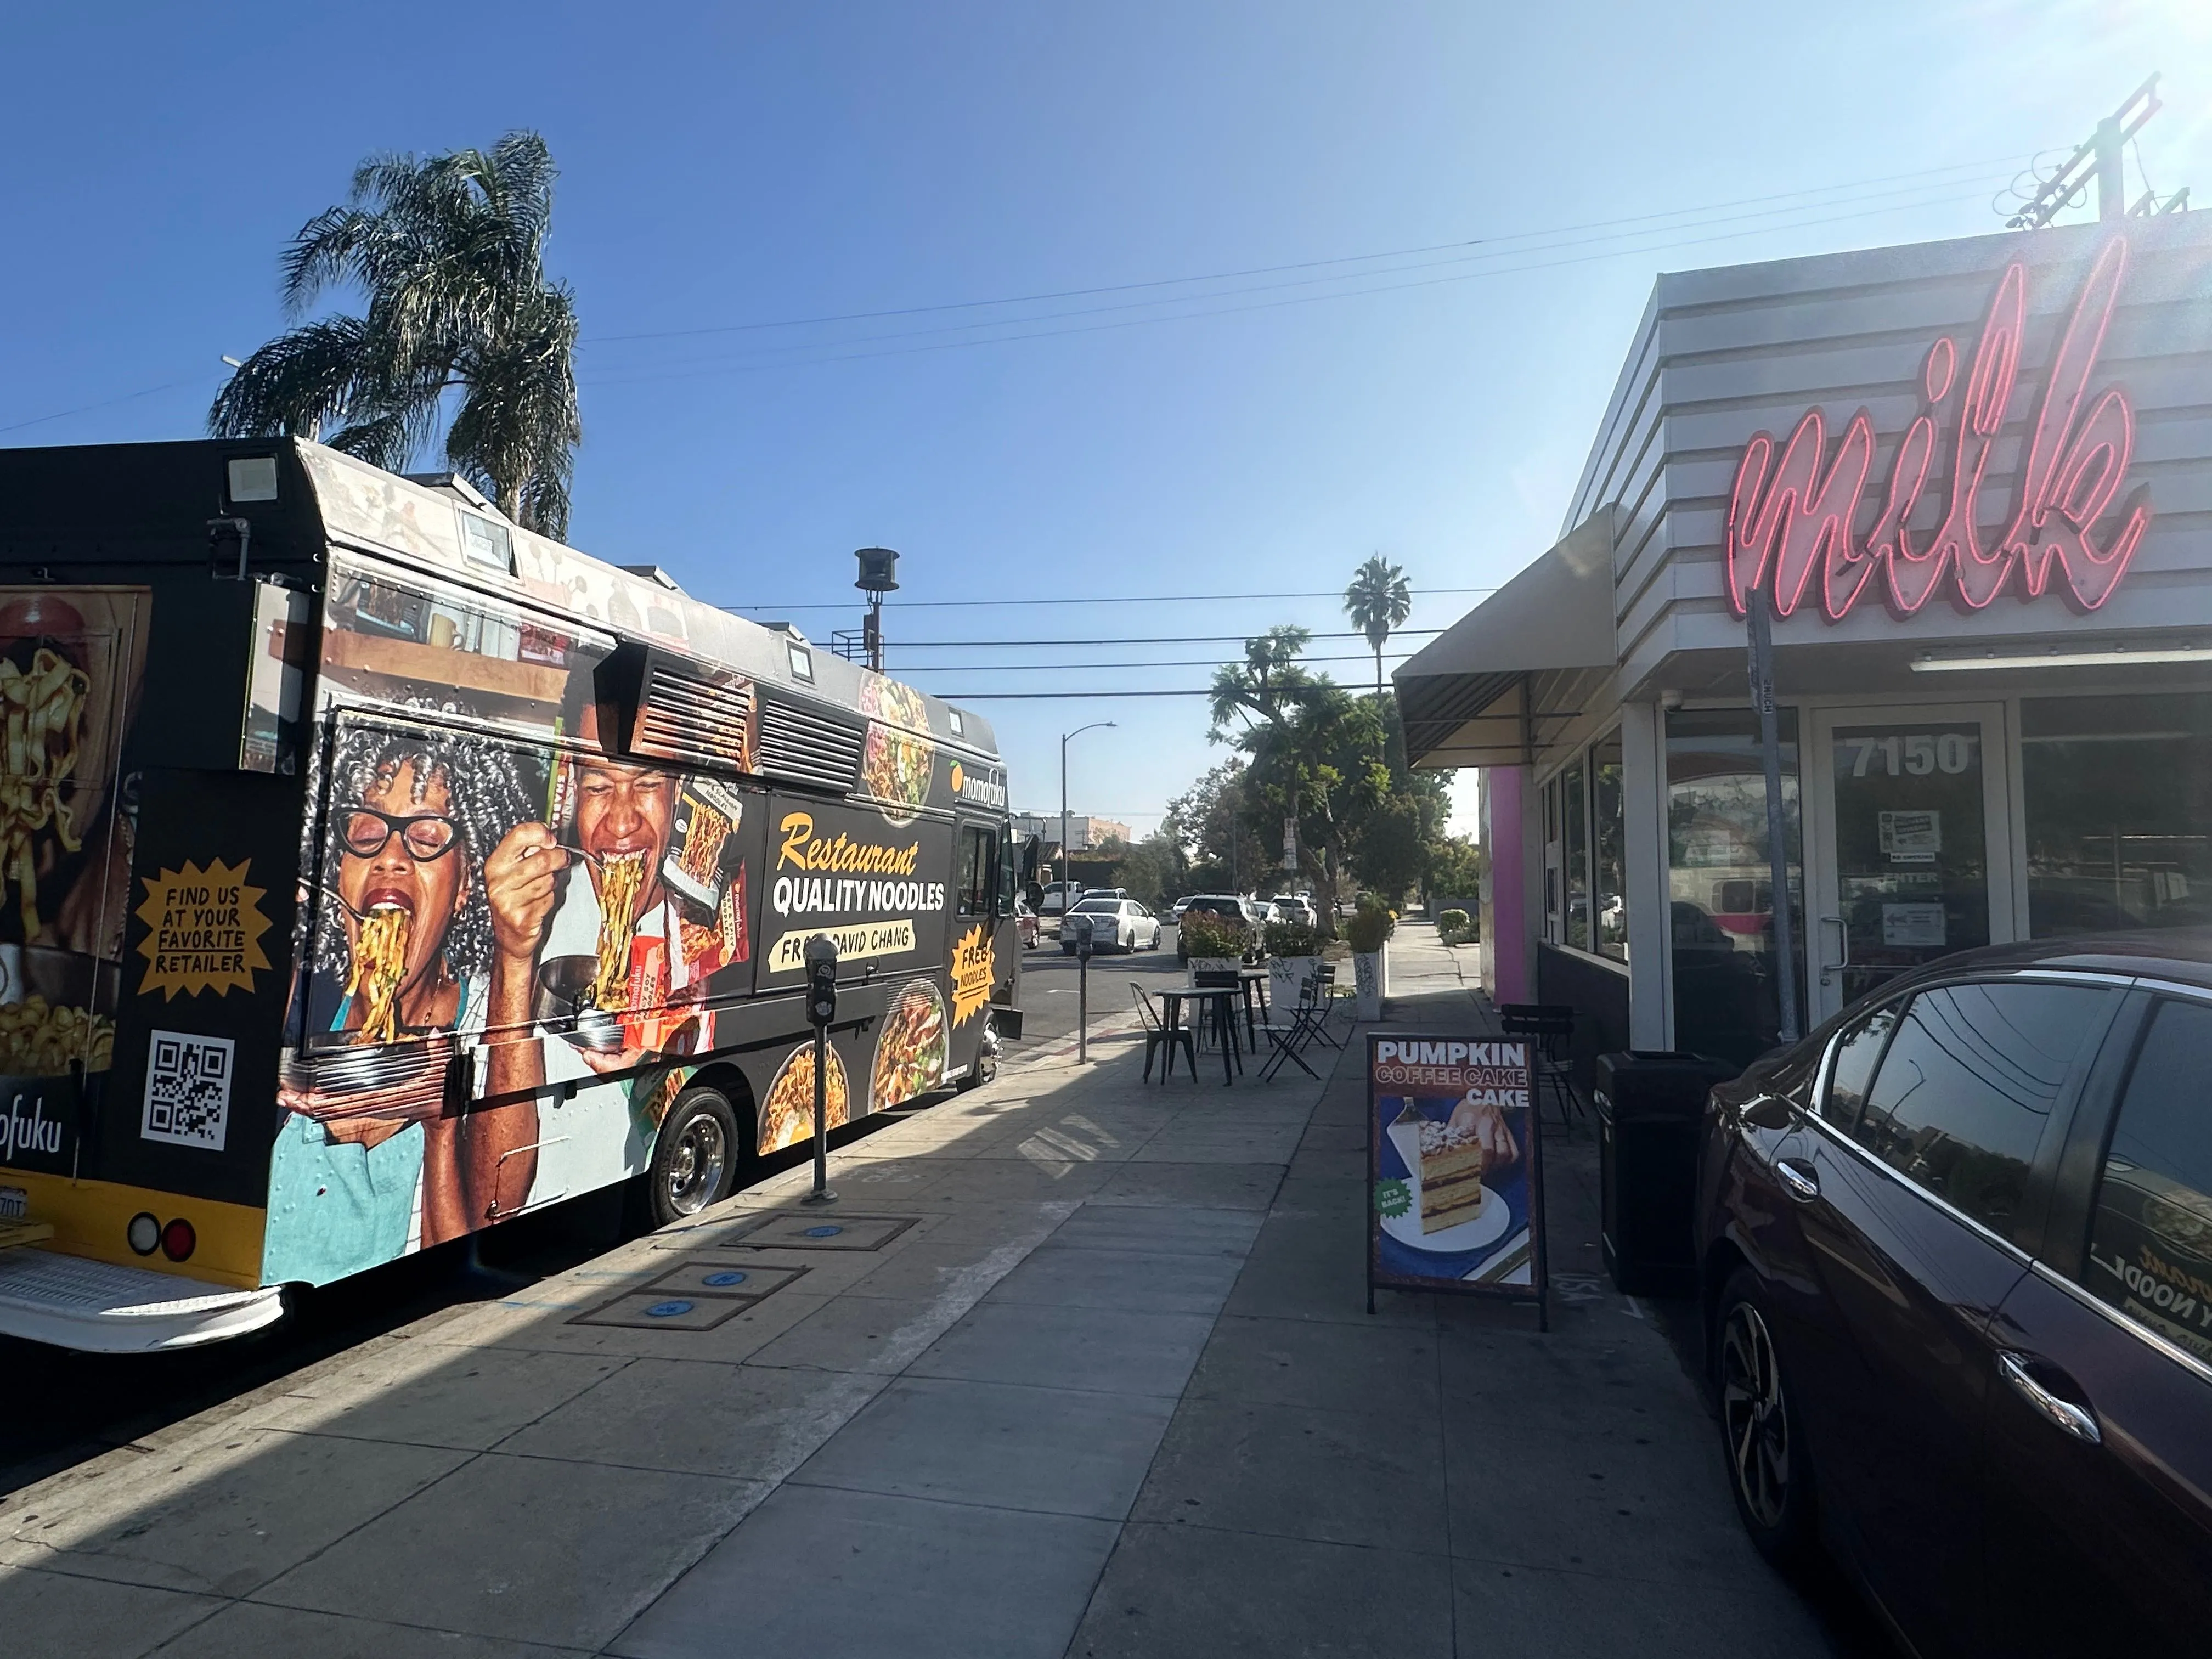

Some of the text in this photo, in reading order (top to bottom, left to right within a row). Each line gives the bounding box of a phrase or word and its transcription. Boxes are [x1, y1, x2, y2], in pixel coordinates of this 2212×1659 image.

[1721, 235, 2154, 627] milk
[1846, 733, 1968, 777] 7150
[962, 768, 1005, 808] momofuku
[777, 812, 919, 876] Restaurant
[166, 885, 240, 906] FIND US
[773, 876, 945, 918] QUALITY NOODLES
[162, 907, 240, 927] AT YOUR
[158, 929, 246, 949] FAVORITE
[781, 934, 817, 964] FR
[871, 926, 909, 950] CHANG
[156, 953, 246, 974] RETAILER
[960, 966, 987, 988] NOODLES
[1378, 1041, 1525, 1066] PUMPKIN
[1376, 1065, 1528, 1087] COFFEE CAKE
[1466, 1088, 1530, 1107] CAKE
